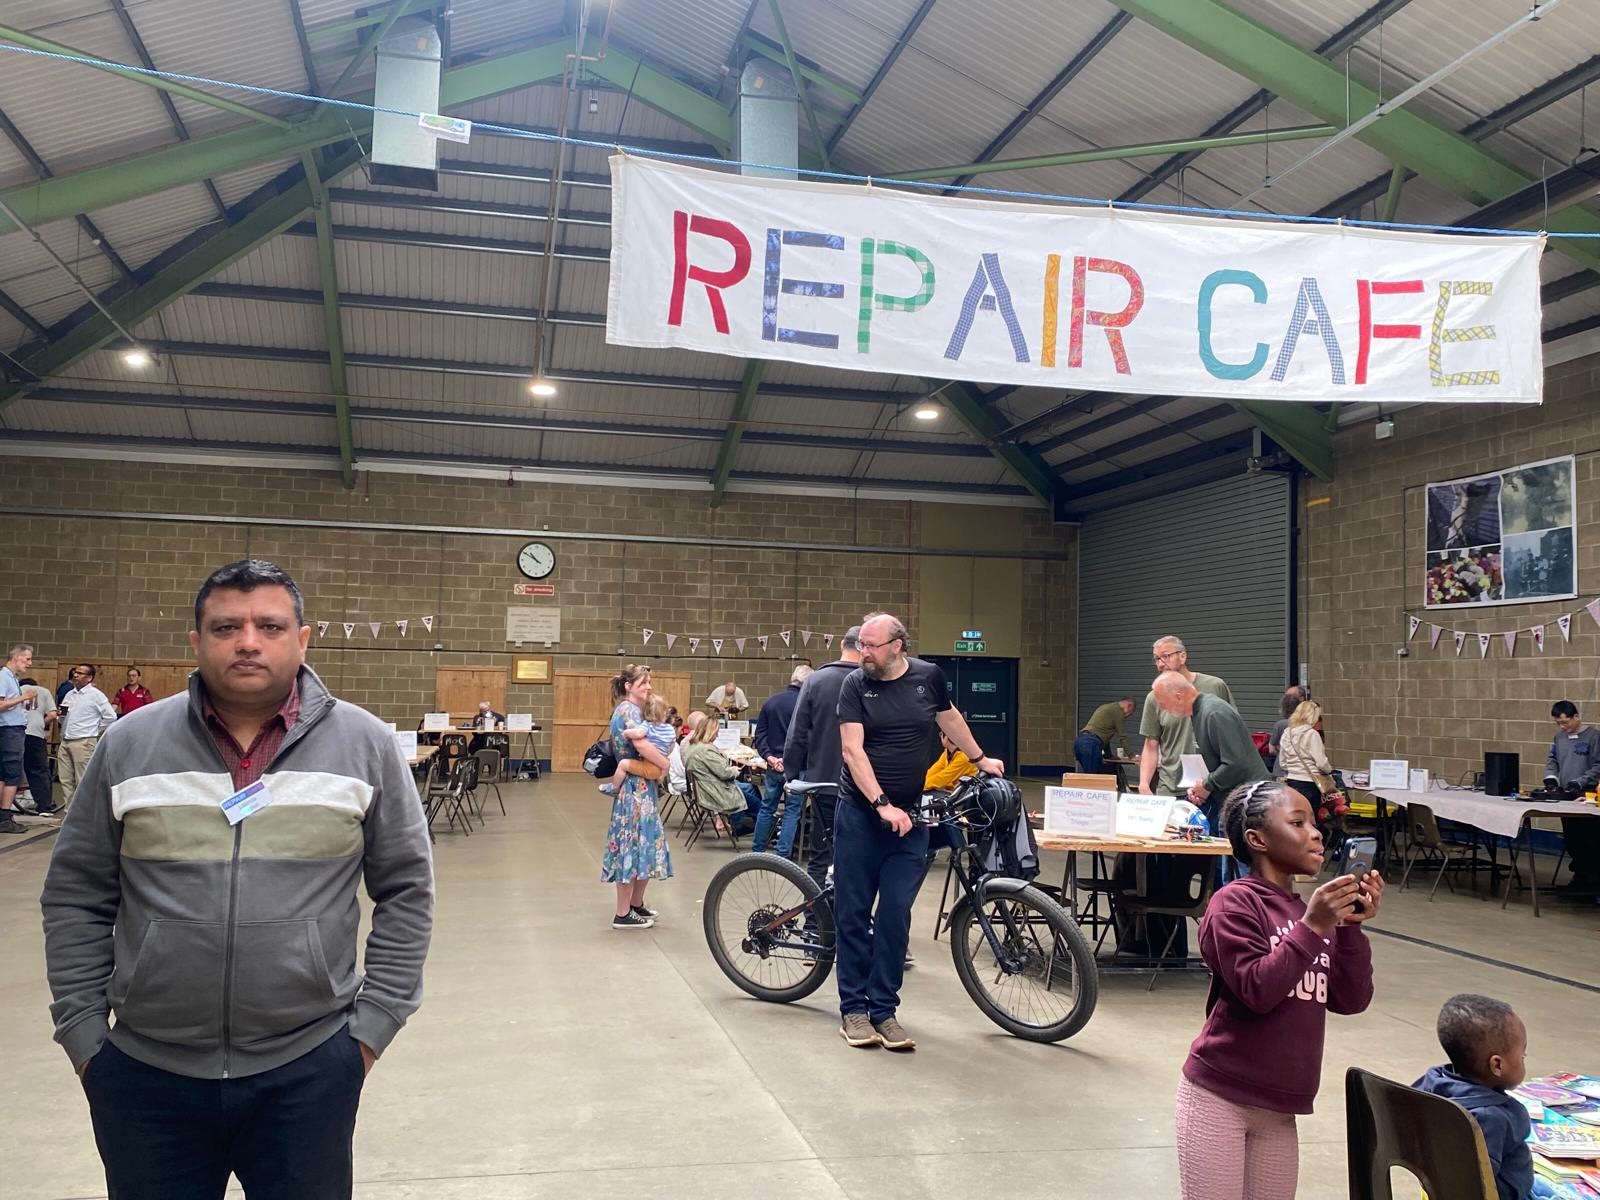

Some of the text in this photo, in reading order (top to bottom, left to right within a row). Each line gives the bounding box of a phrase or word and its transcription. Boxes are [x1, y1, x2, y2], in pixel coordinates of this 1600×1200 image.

[668, 210, 1500, 387] REPAIR CAFE
[1052, 789, 1109, 801] REPAIR CAFE
[1287, 970, 1328, 1004] LUB
